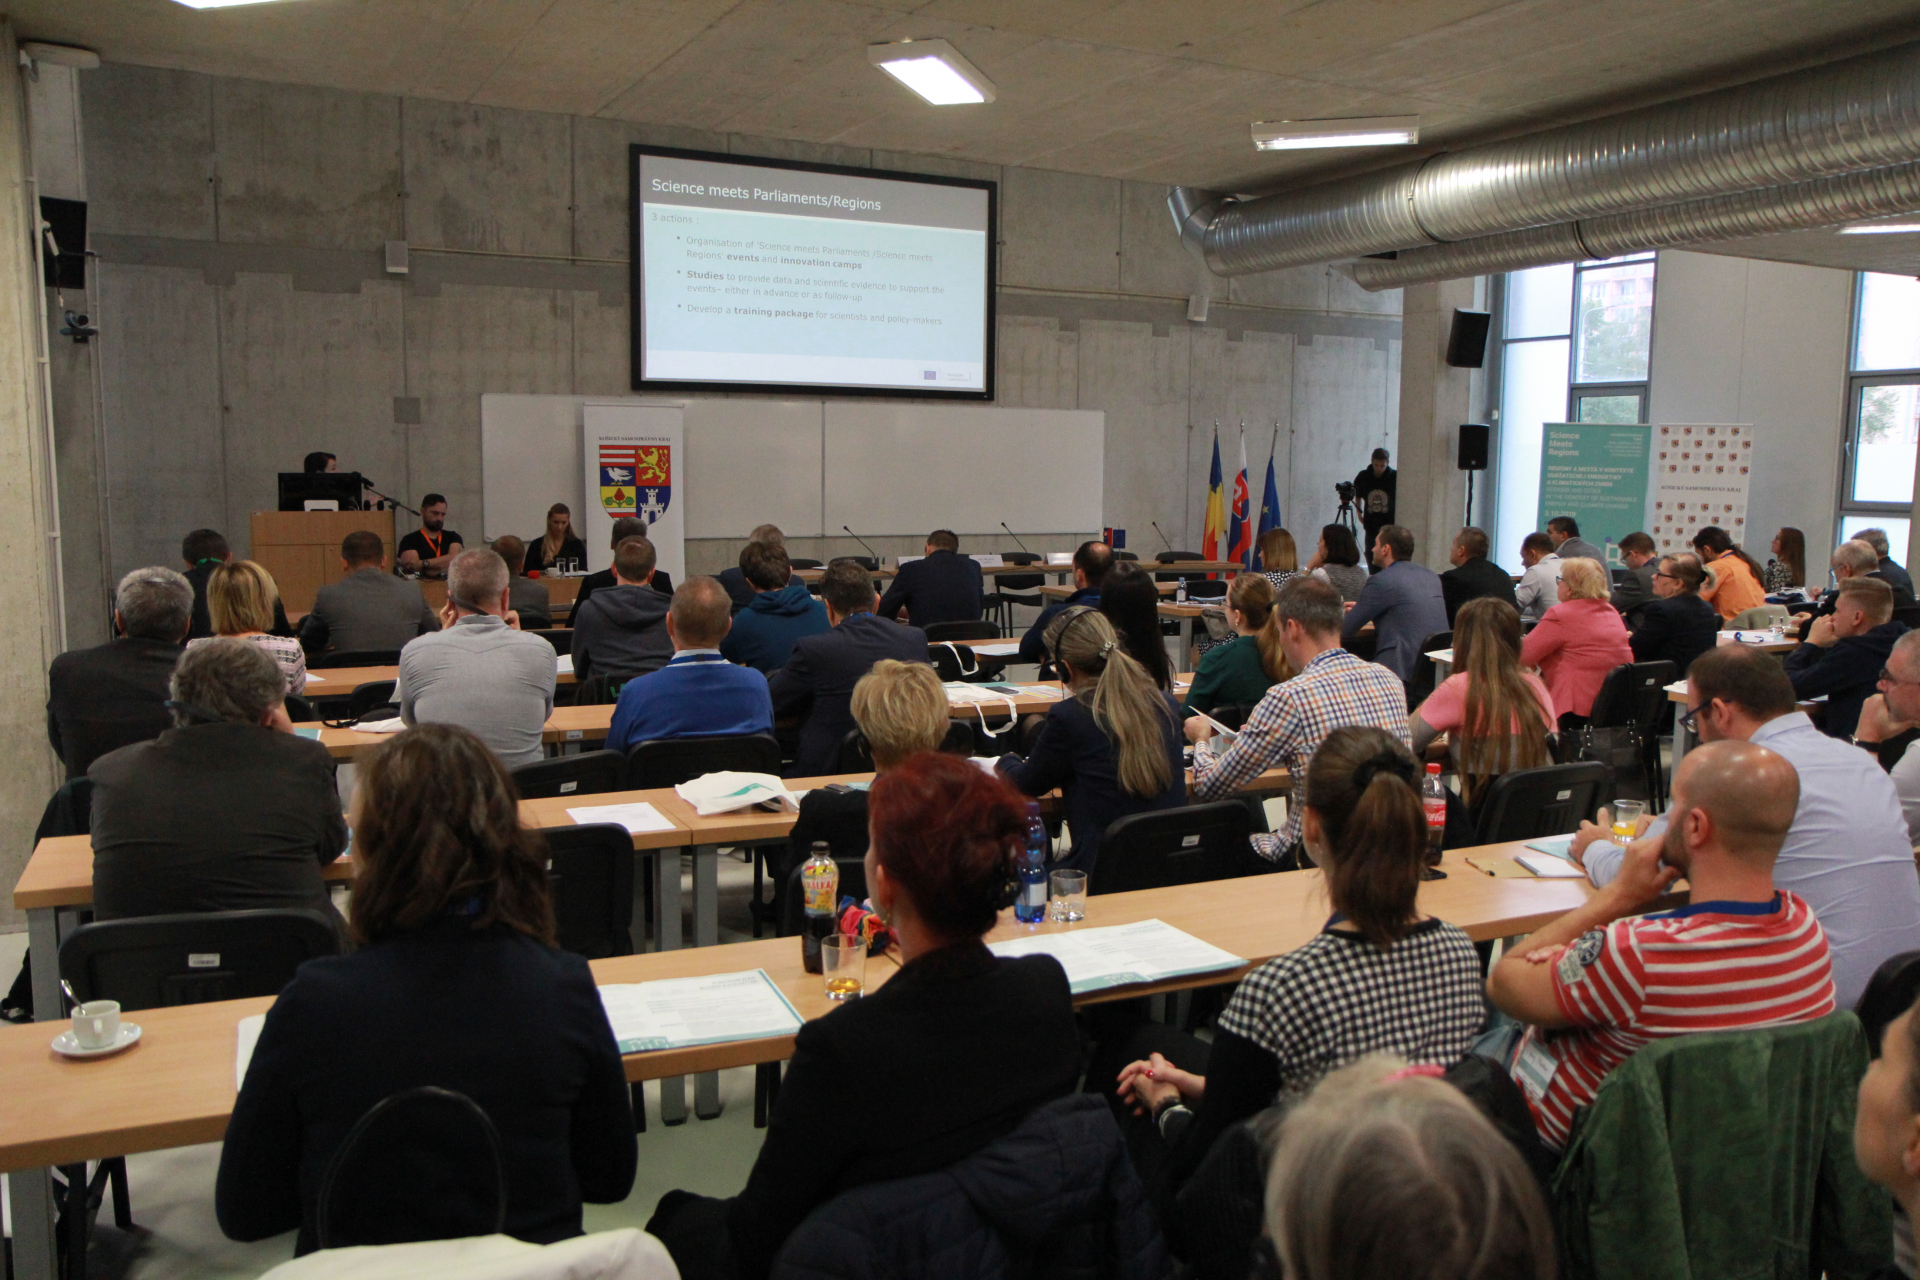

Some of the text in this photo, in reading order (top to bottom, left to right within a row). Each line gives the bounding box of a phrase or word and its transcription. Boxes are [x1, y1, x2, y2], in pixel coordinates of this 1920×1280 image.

[652, 179, 882, 211] Science meets Parliaments/Regions
[651, 213, 657, 221] 3
[660, 214, 693, 224] actions
[686, 236, 743, 248] Organisation
[745, 241, 754, 249] of
[794, 245, 820, 254] meets
[822, 246, 871, 257] Parliaments
[909, 254, 933, 262] meets
[727, 254, 760, 262] events
[762, 256, 778, 264] and
[780, 256, 831, 267] innovation
[833, 261, 862, 270] camps
[687, 270, 724, 280] Studies
[726, 273, 735, 281] to
[738, 274, 771, 283] provide
[773, 276, 792, 284] data
[813, 278, 848, 288] scientific
[851, 281, 886, 290] evidence
[889, 283, 897, 291] to
[900, 284, 930, 294] support
[932, 286, 945, 294] the
[725, 286, 750, 295] either
[763, 288, 799, 298] advance
[824, 292, 862, 302] follow-up
[687, 304, 723, 315] Develop
[734, 306, 772, 317] training
[774, 309, 813, 319] package
[815, 311, 827, 319] for
[830, 312, 868, 321] scientists
[870, 314, 885, 322] and
[887, 315, 943, 325] policy-makers
[1549, 431, 1580, 440] Science
[1548, 440, 1573, 448] Meets
[1548, 448, 1579, 457] Regions
